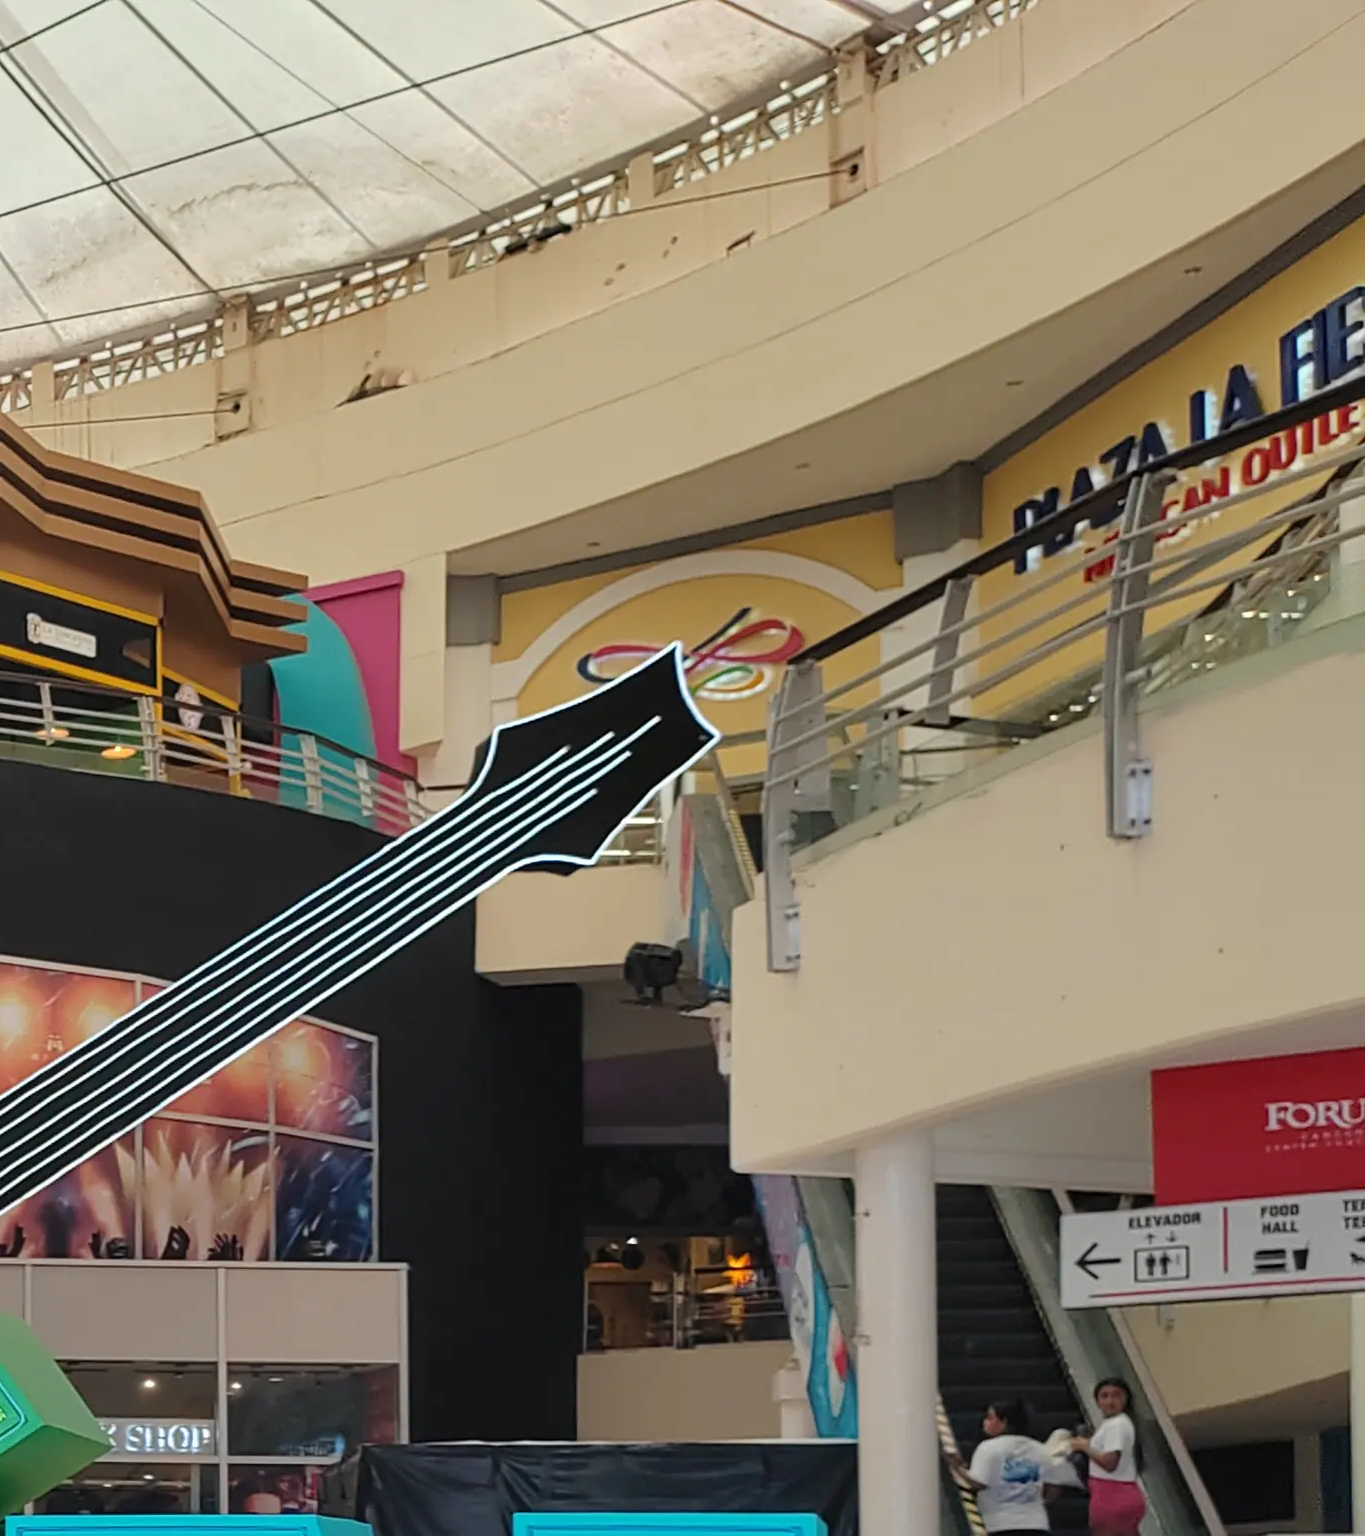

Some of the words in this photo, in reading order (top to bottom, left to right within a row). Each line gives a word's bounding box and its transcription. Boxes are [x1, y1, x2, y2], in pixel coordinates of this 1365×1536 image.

[1128, 1211, 1202, 1230] ELEVADOR
[1260, 1203, 1300, 1220] FOOD
[1261, 1220, 1300, 1235] HALL
[124, 1423, 211, 1453] SHOP
